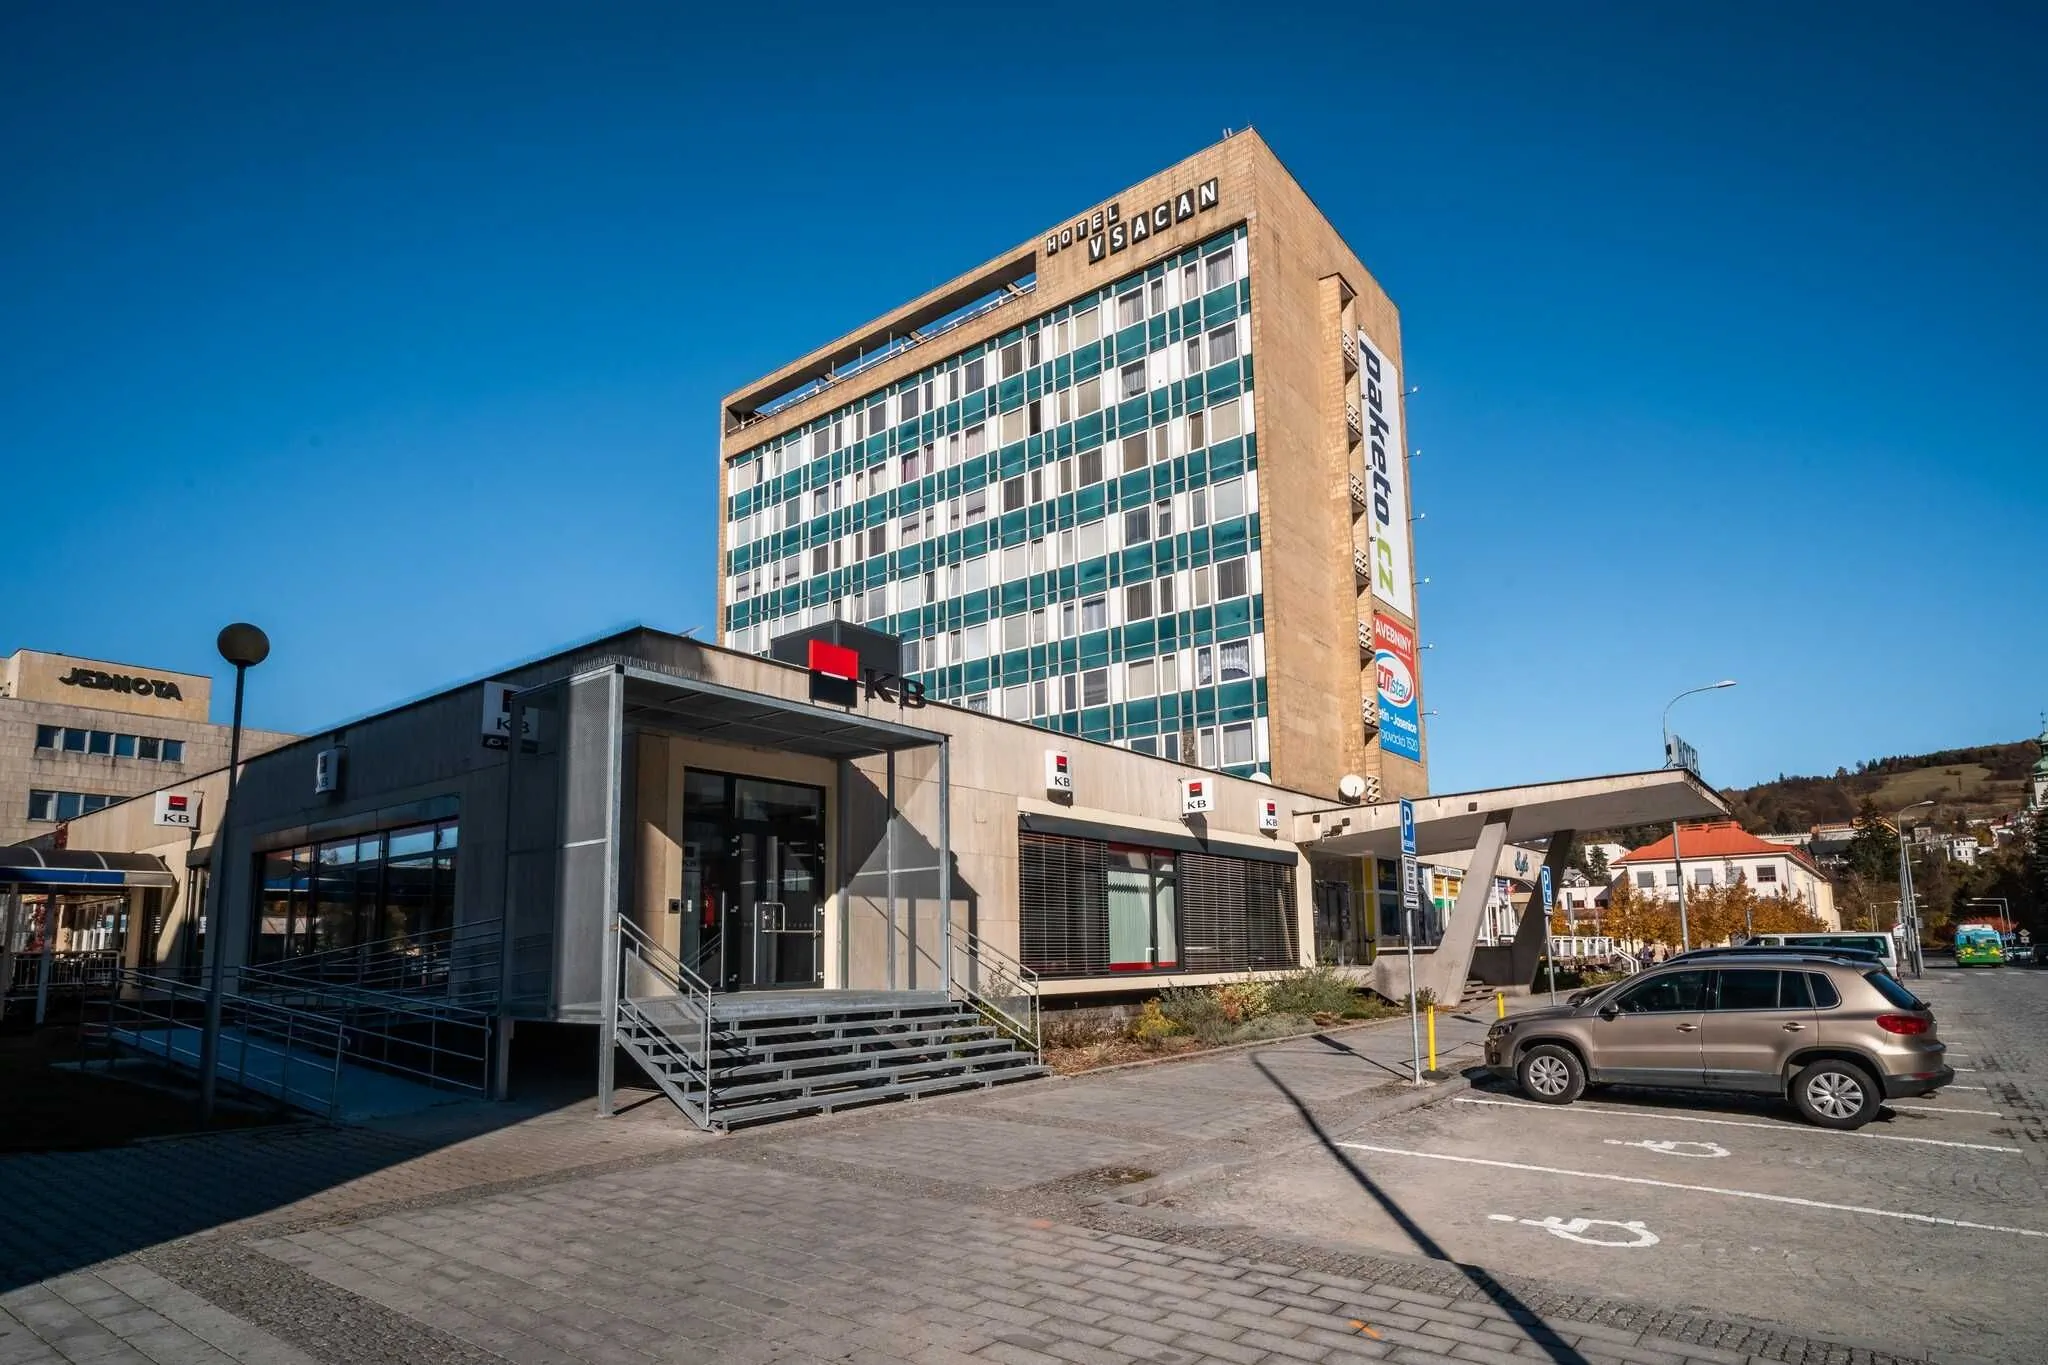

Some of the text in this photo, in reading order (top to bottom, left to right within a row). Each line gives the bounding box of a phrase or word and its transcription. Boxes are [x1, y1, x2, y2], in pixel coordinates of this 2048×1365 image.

[1047, 206, 1118, 253] HOTEL
[1090, 179, 1217, 259] VSACAN
[1360, 339, 1394, 596] paketo.cz
[1373, 617, 1412, 655] AVEBNINY
[59, 667, 183, 701] JEDNOTA
[864, 667, 926, 709] KB
[1054, 775, 1071, 787] KB
[163, 813, 190, 824] KB
[1187, 799, 1207, 810] KB
[1403, 805, 1411, 837] P
[1265, 818, 1278, 827] KB
